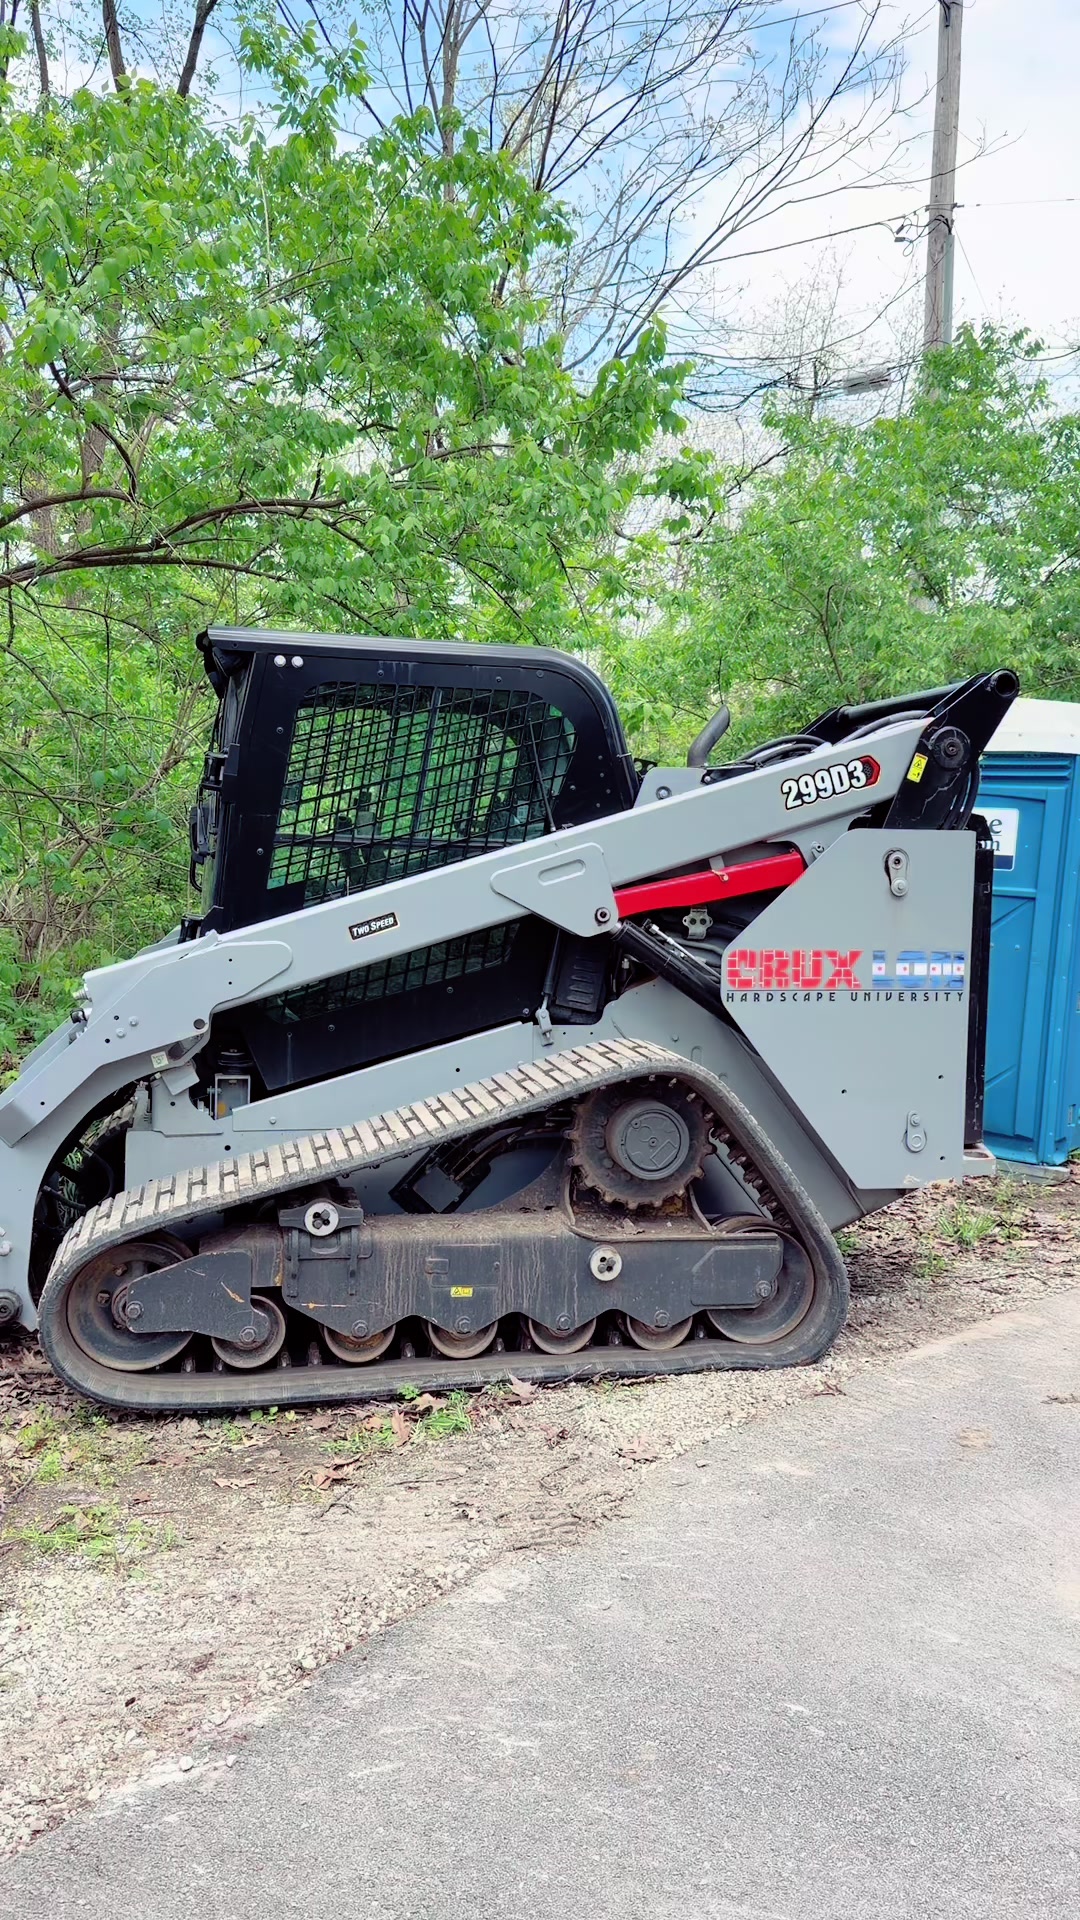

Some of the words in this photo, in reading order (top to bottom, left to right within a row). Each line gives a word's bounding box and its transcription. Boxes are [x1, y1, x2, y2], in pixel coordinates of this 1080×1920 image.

[781, 758, 867, 810] 299D3
[727, 949, 863, 989] CRUX
[726, 991, 837, 1002] HARDSCAPE
[849, 991, 964, 1002] UNIVERSITY
